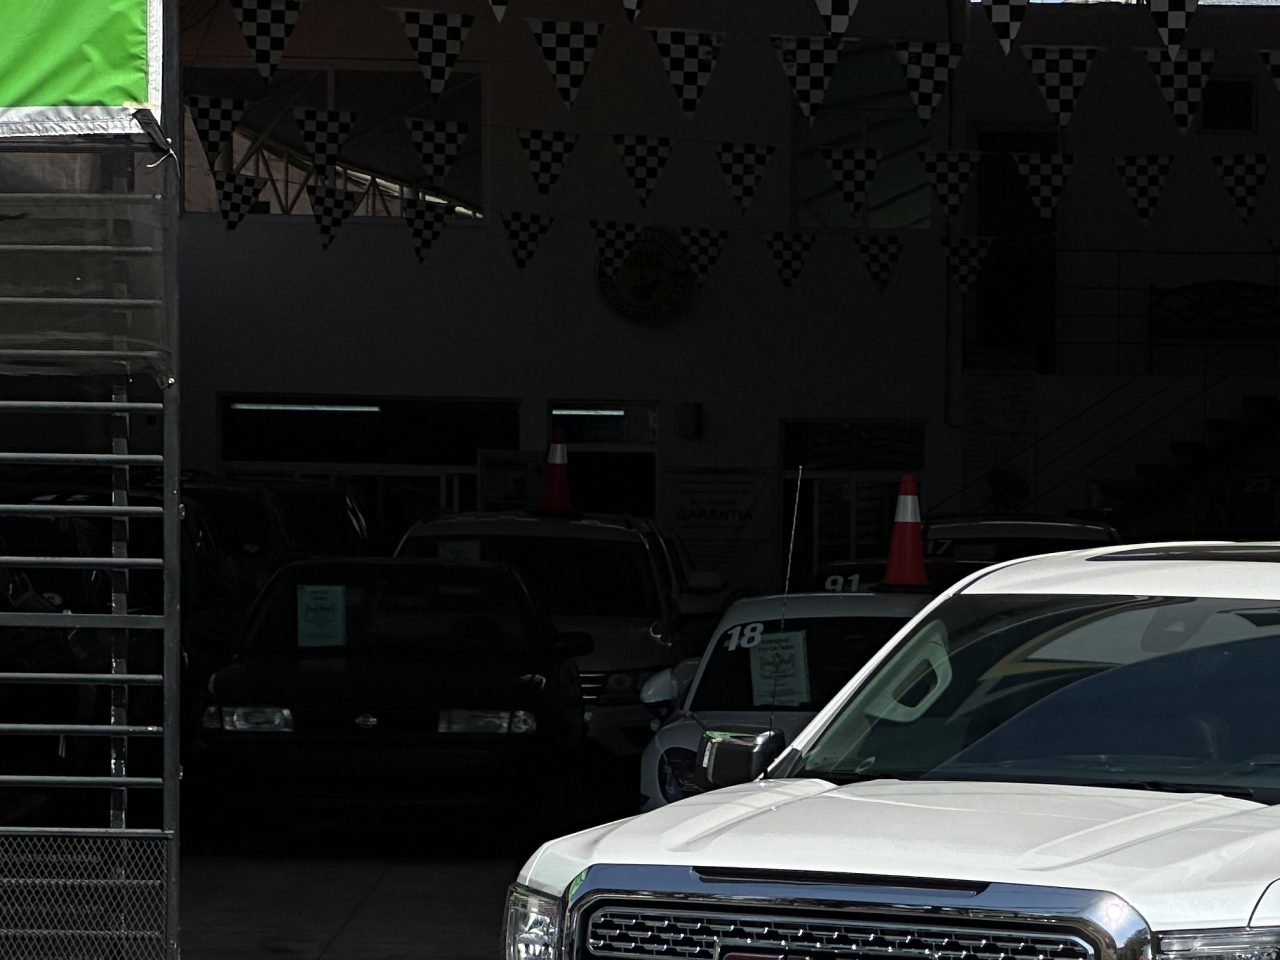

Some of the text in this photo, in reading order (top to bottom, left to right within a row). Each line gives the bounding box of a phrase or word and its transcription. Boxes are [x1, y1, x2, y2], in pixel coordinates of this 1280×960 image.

[1241, 477, 1272, 493] 23
[824, 573, 860, 592] 91
[722, 622, 765, 652] 18
